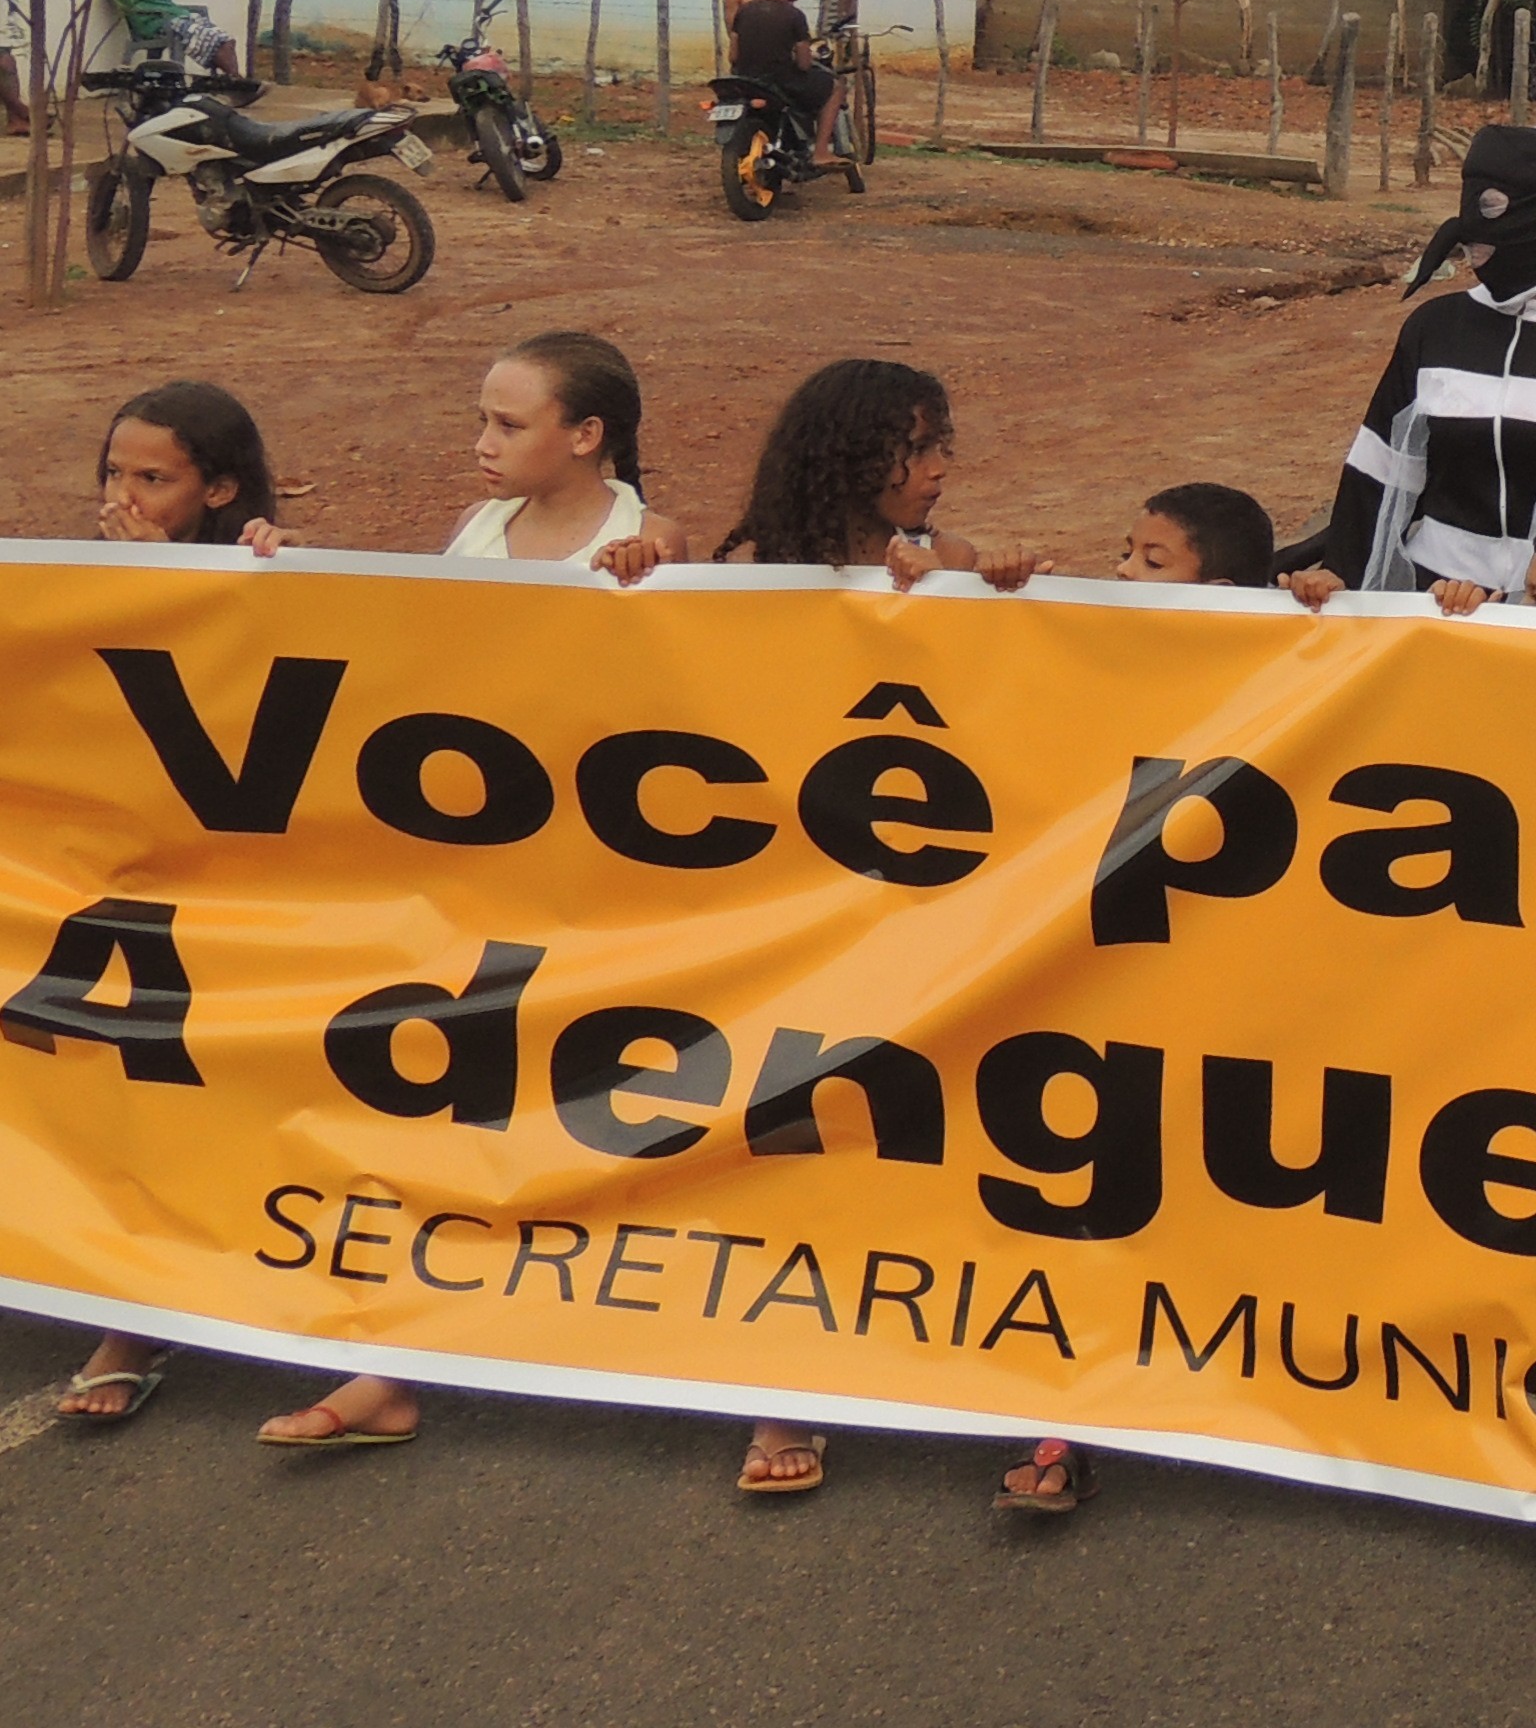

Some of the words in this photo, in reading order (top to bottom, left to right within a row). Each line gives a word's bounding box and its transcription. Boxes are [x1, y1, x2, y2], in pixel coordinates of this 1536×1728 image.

[94, 648, 993, 888] Você
[0, 897, 206, 1088] A
[254, 1184, 1078, 1362] SECRETARIA
